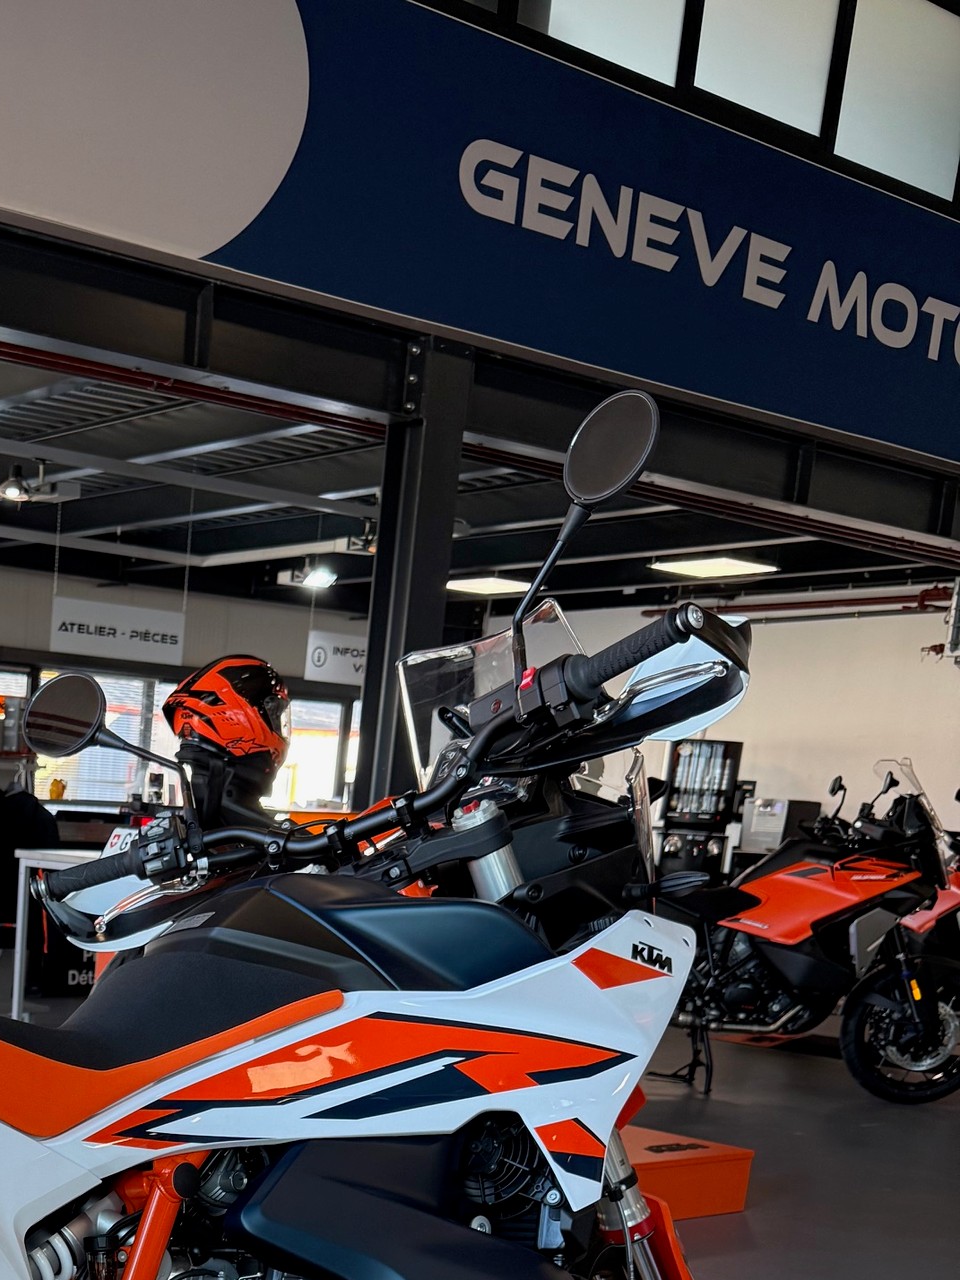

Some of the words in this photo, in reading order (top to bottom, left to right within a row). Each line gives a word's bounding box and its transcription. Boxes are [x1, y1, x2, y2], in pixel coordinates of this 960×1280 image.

[458, 138, 793, 309] GENEVE
[806, 260, 960, 367] MOT
[58, 621, 117, 638] ATELIER
[130, 629, 178, 645] PIÈCES
[631, 941, 673, 974] KTM
[68, 969, 95, 985] Dét
